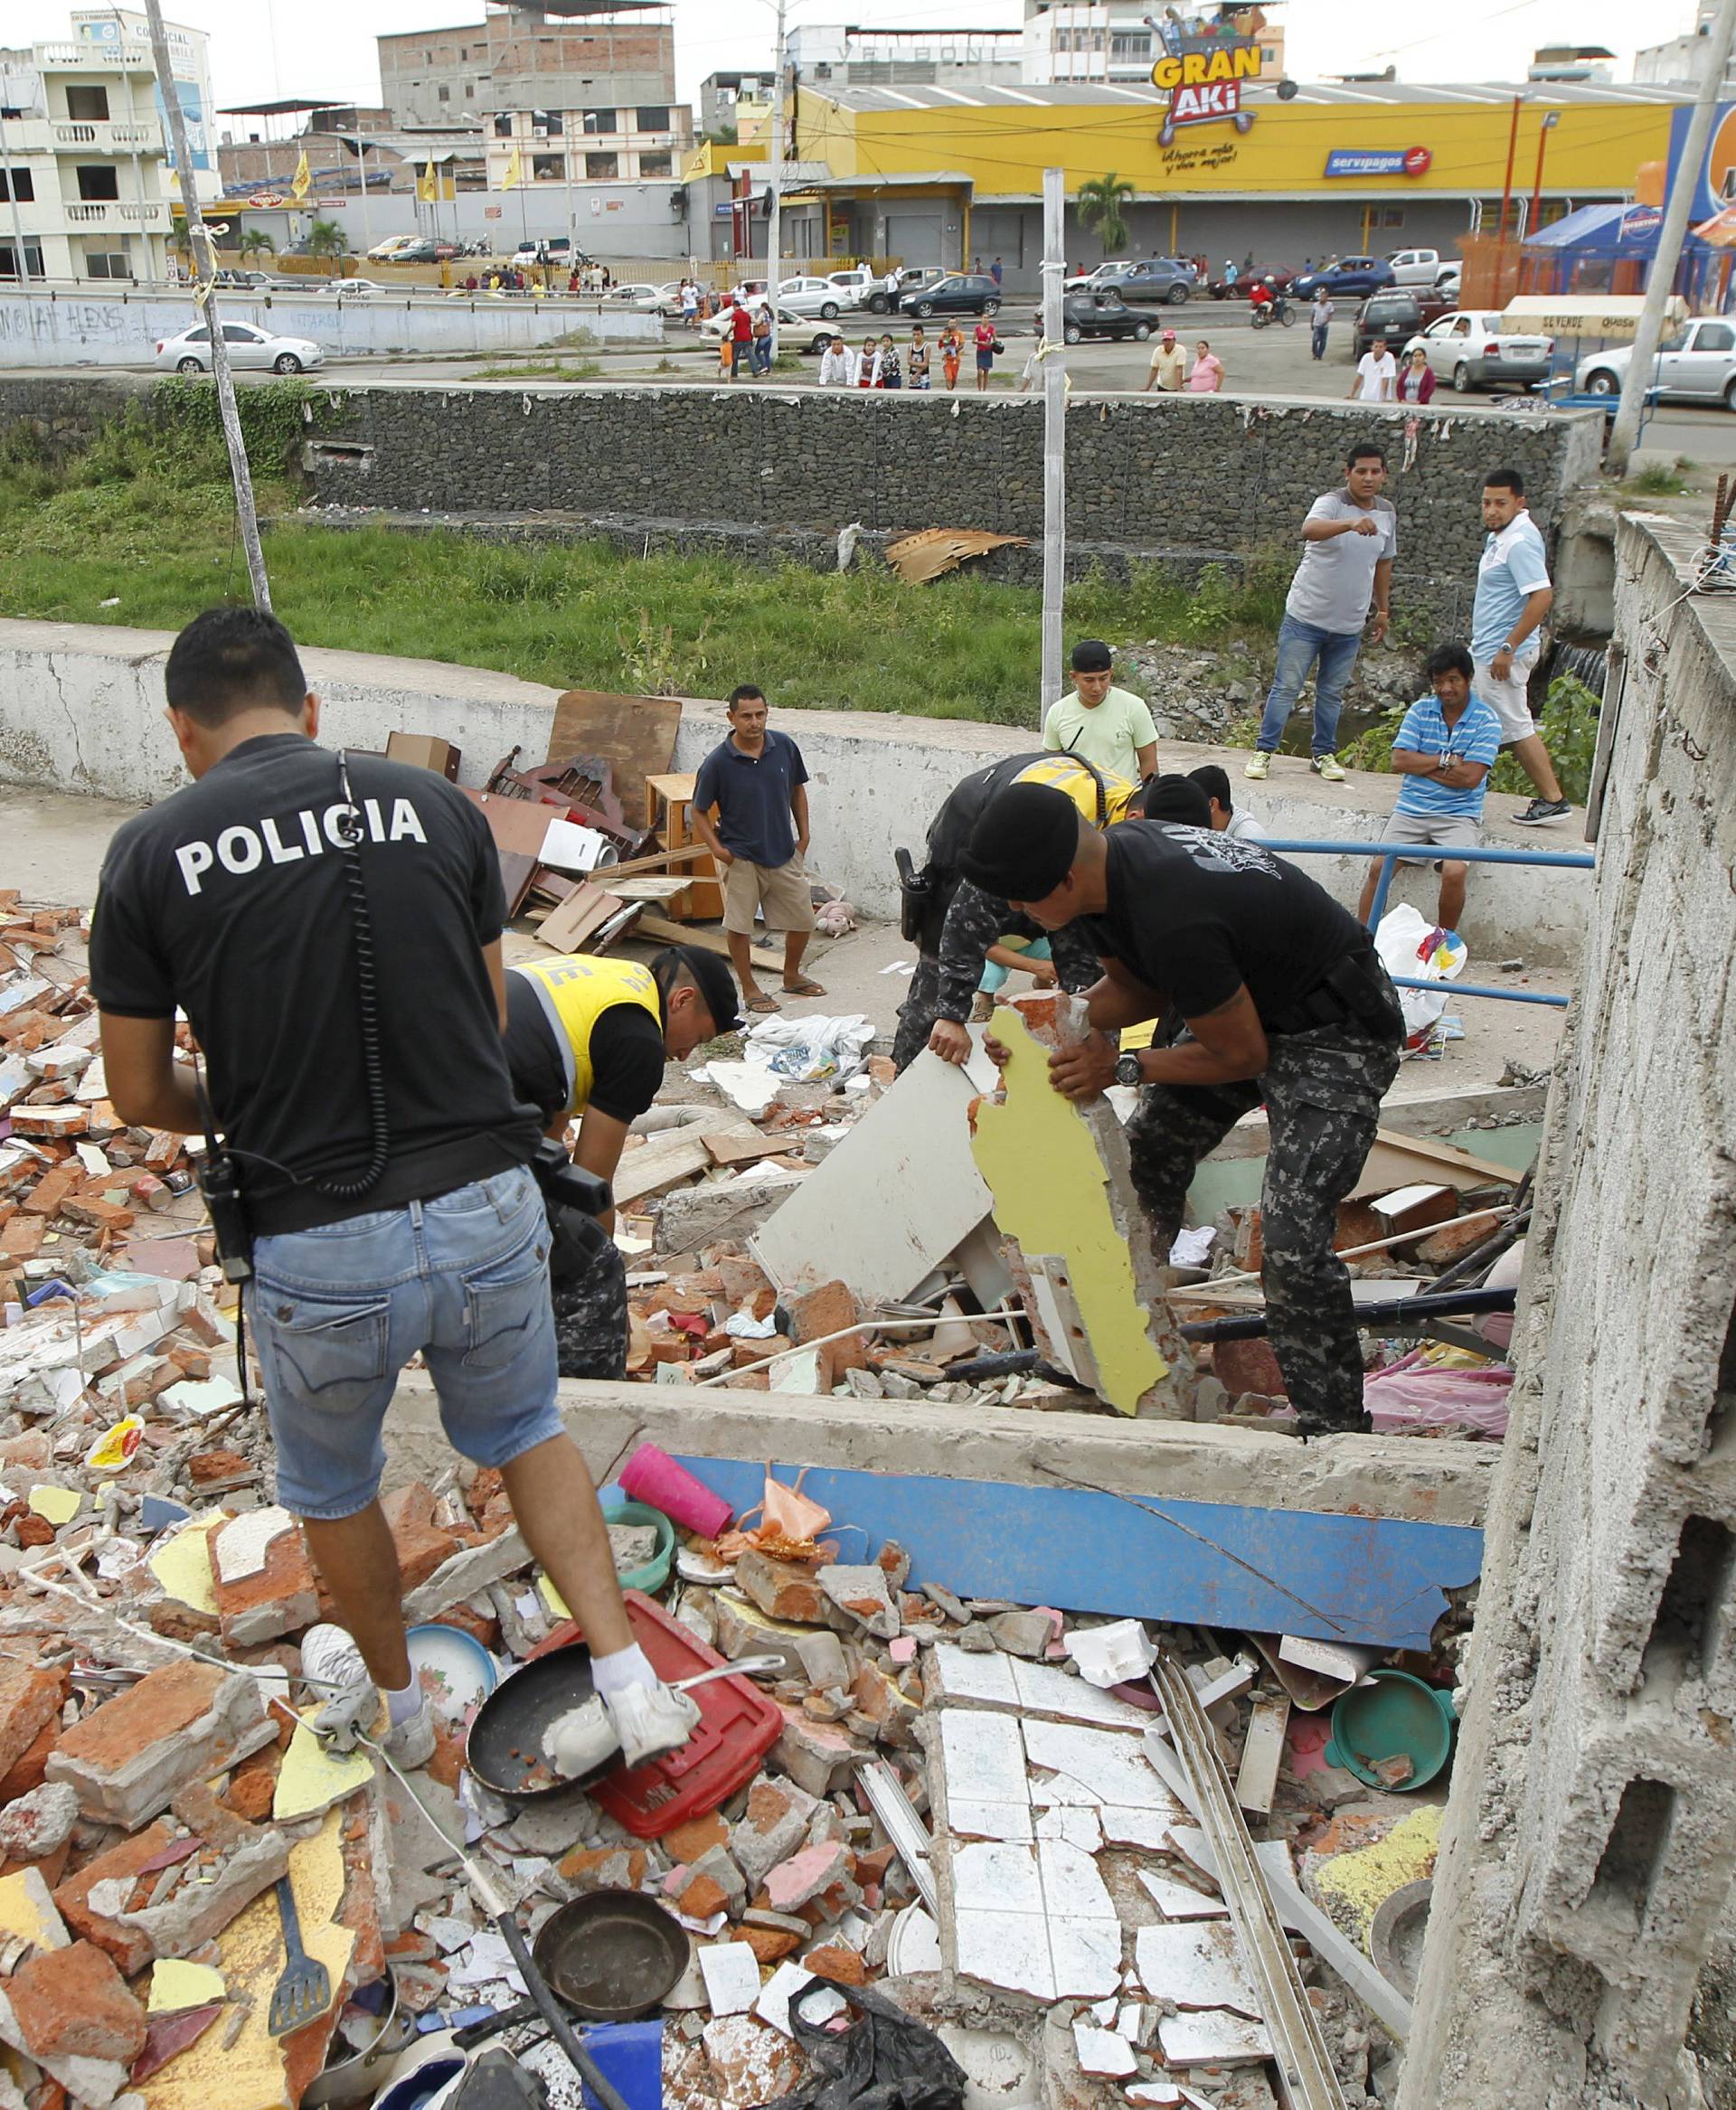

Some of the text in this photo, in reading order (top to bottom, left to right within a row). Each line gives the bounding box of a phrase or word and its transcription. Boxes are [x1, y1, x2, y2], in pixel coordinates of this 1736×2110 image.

[1152, 45, 1261, 89] GRAN
[1332, 156, 1403, 170] servipagos
[175, 798, 428, 896] POLICIA
